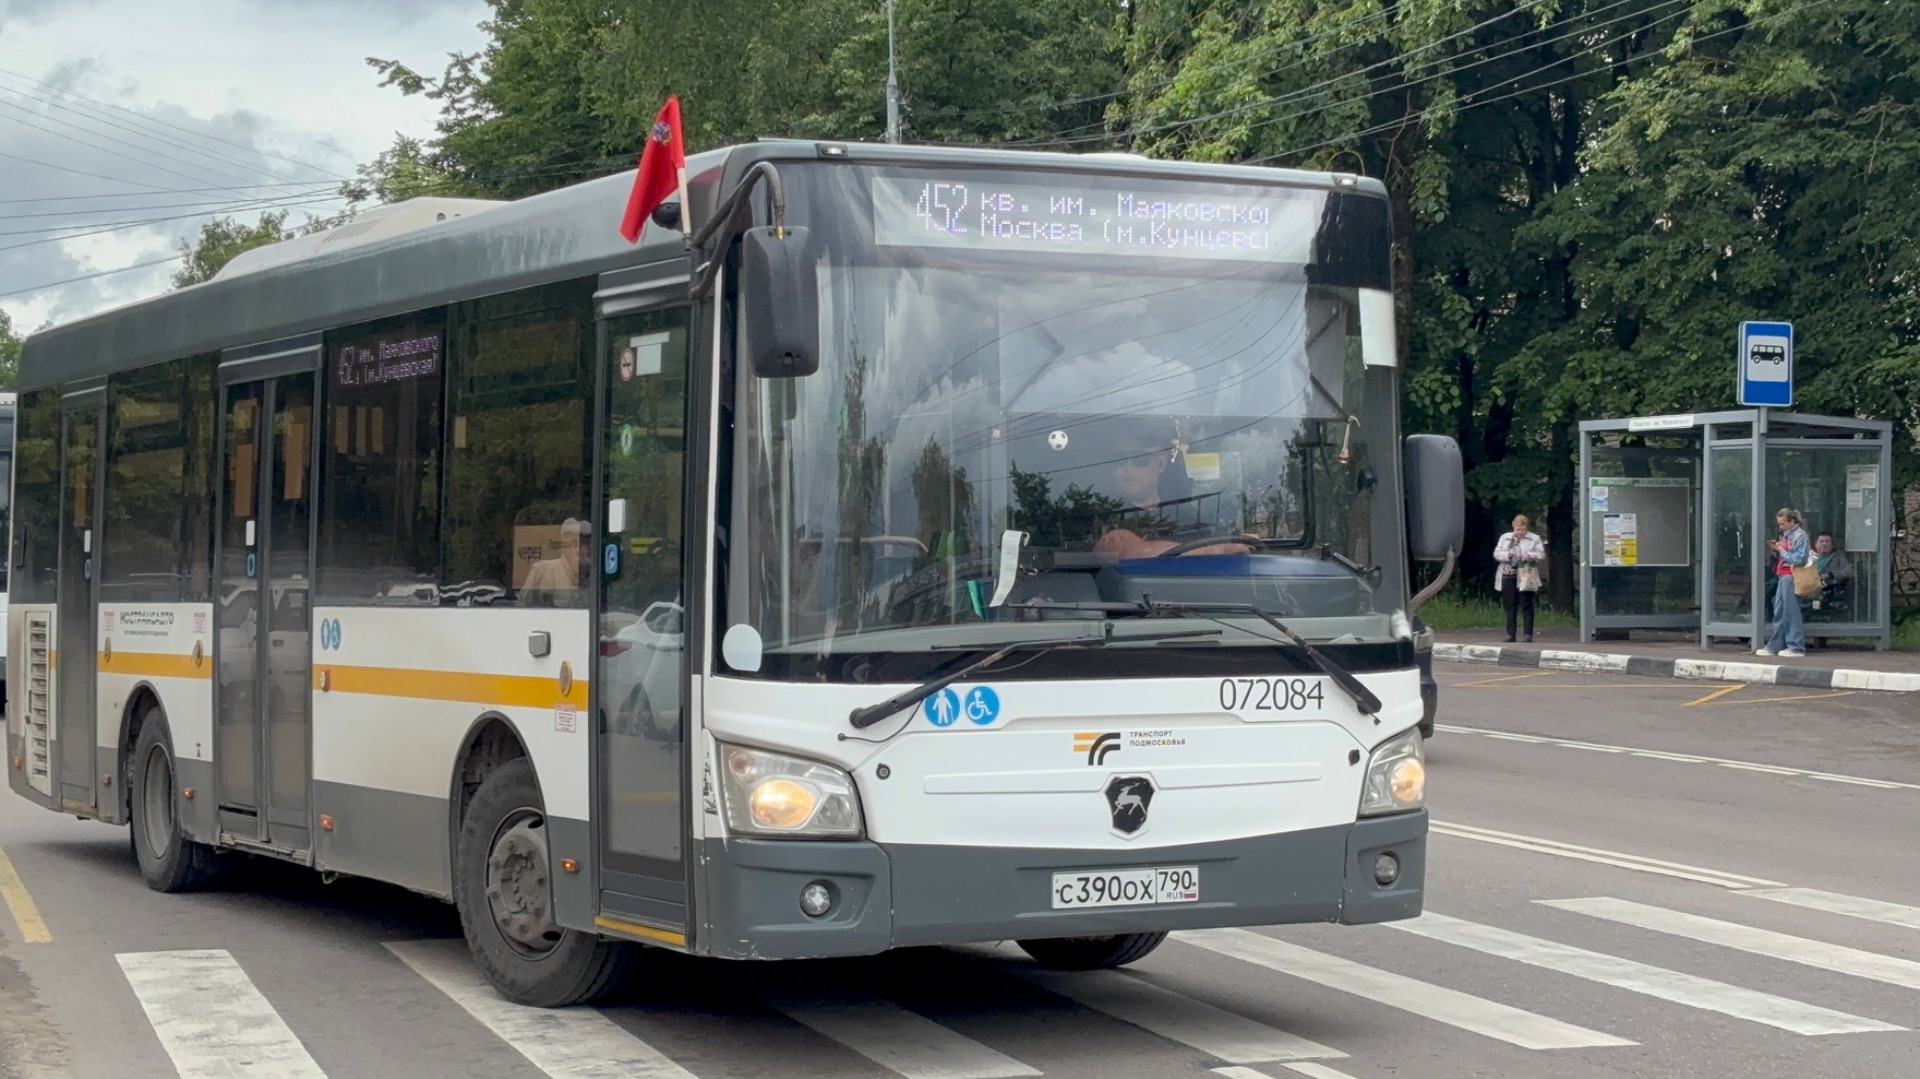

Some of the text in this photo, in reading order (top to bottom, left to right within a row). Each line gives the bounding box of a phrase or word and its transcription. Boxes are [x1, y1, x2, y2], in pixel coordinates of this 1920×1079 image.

[916, 182, 968, 233] 452
[981, 192, 1269, 225] кв. им. Маяковско
[980, 212, 1269, 251] Москва (м.Кунцевс
[1219, 678, 1325, 711] 072084
[1129, 730, 1173, 738] ТРАНСПОРТ
[1129, 739, 1186, 747] ПОДМОСКОВЬЯ
[1158, 870, 1193, 891] 790
[1166, 891, 1184, 899] RUS
